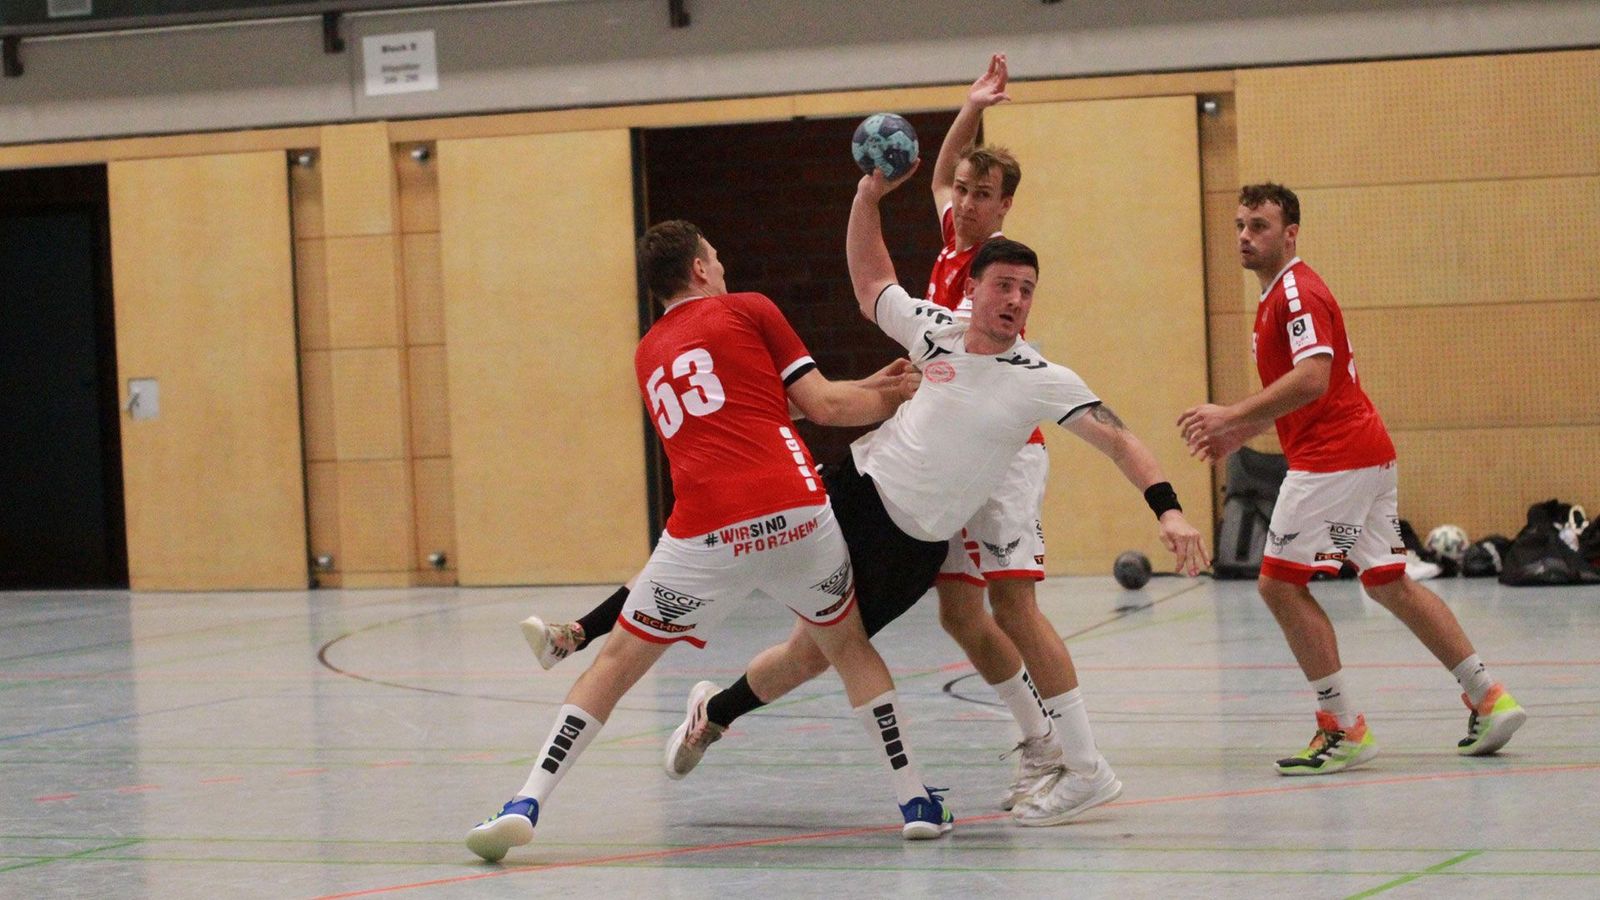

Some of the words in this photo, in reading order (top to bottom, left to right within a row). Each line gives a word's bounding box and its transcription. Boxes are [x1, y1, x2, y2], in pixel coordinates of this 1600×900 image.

[646, 348, 725, 439] 53
[734, 517, 818, 557] PFORZHEIM
[654, 587, 702, 607] KOCH
